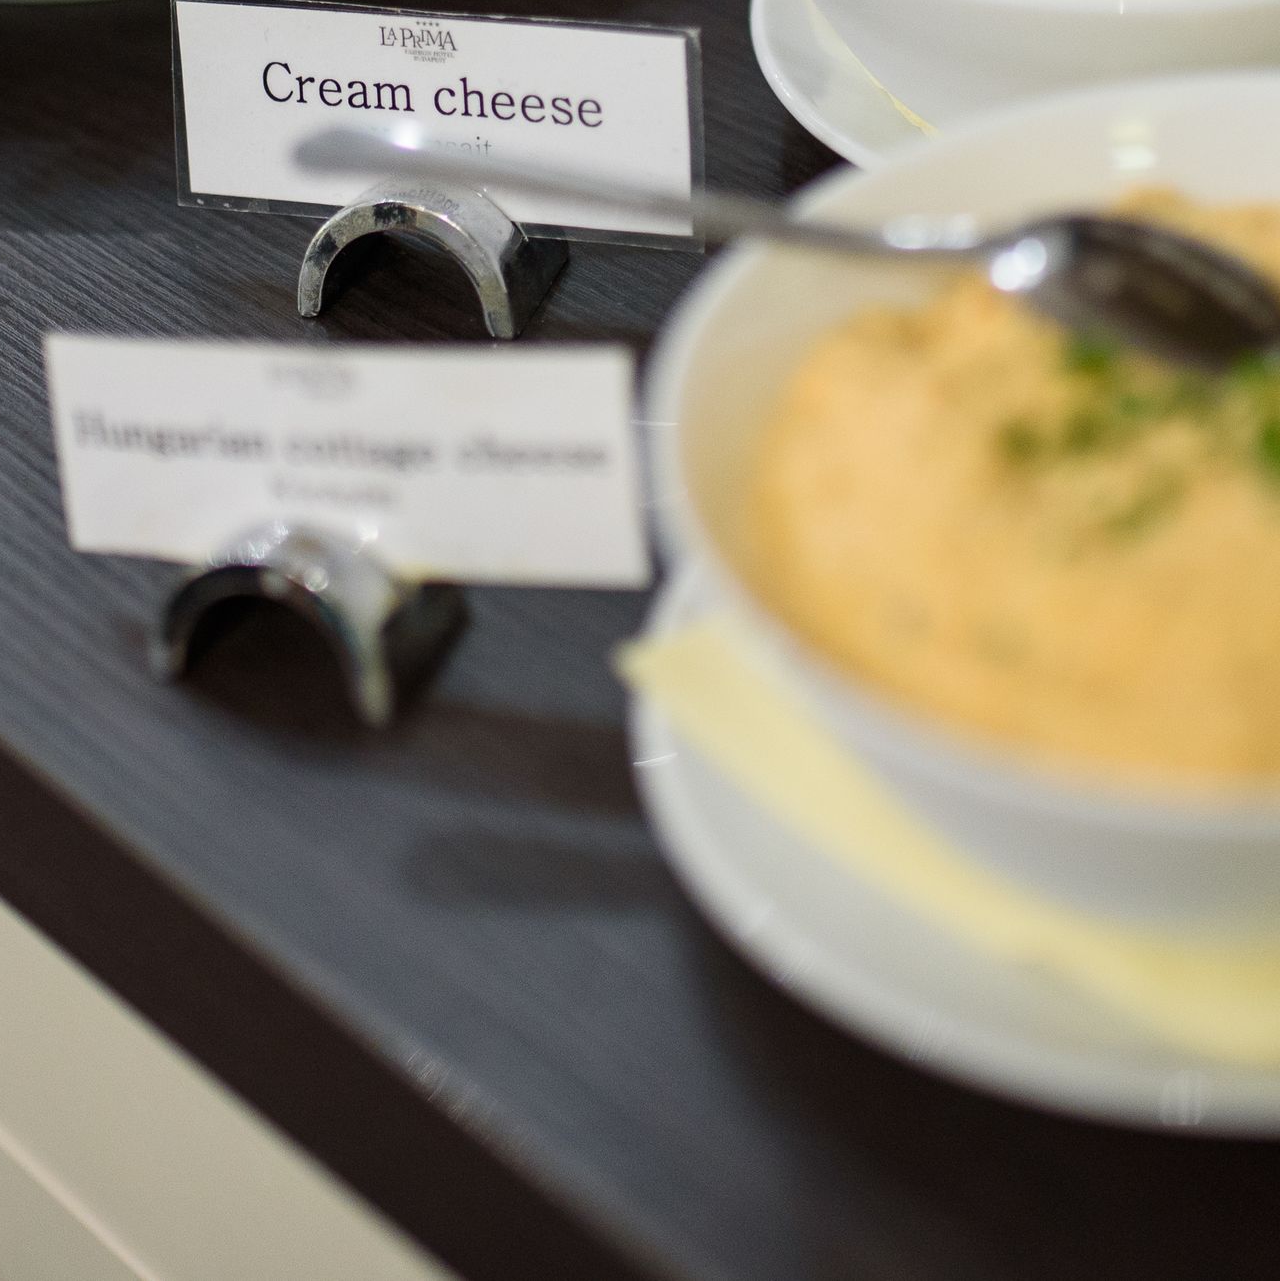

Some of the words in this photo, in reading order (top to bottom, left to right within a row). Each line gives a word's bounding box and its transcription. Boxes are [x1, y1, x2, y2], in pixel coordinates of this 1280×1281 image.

[379, 26, 398, 46] LA
[400, 27, 458, 51] PRIMA
[261, 60, 415, 113] Cream
[433, 77, 604, 128] cheese
